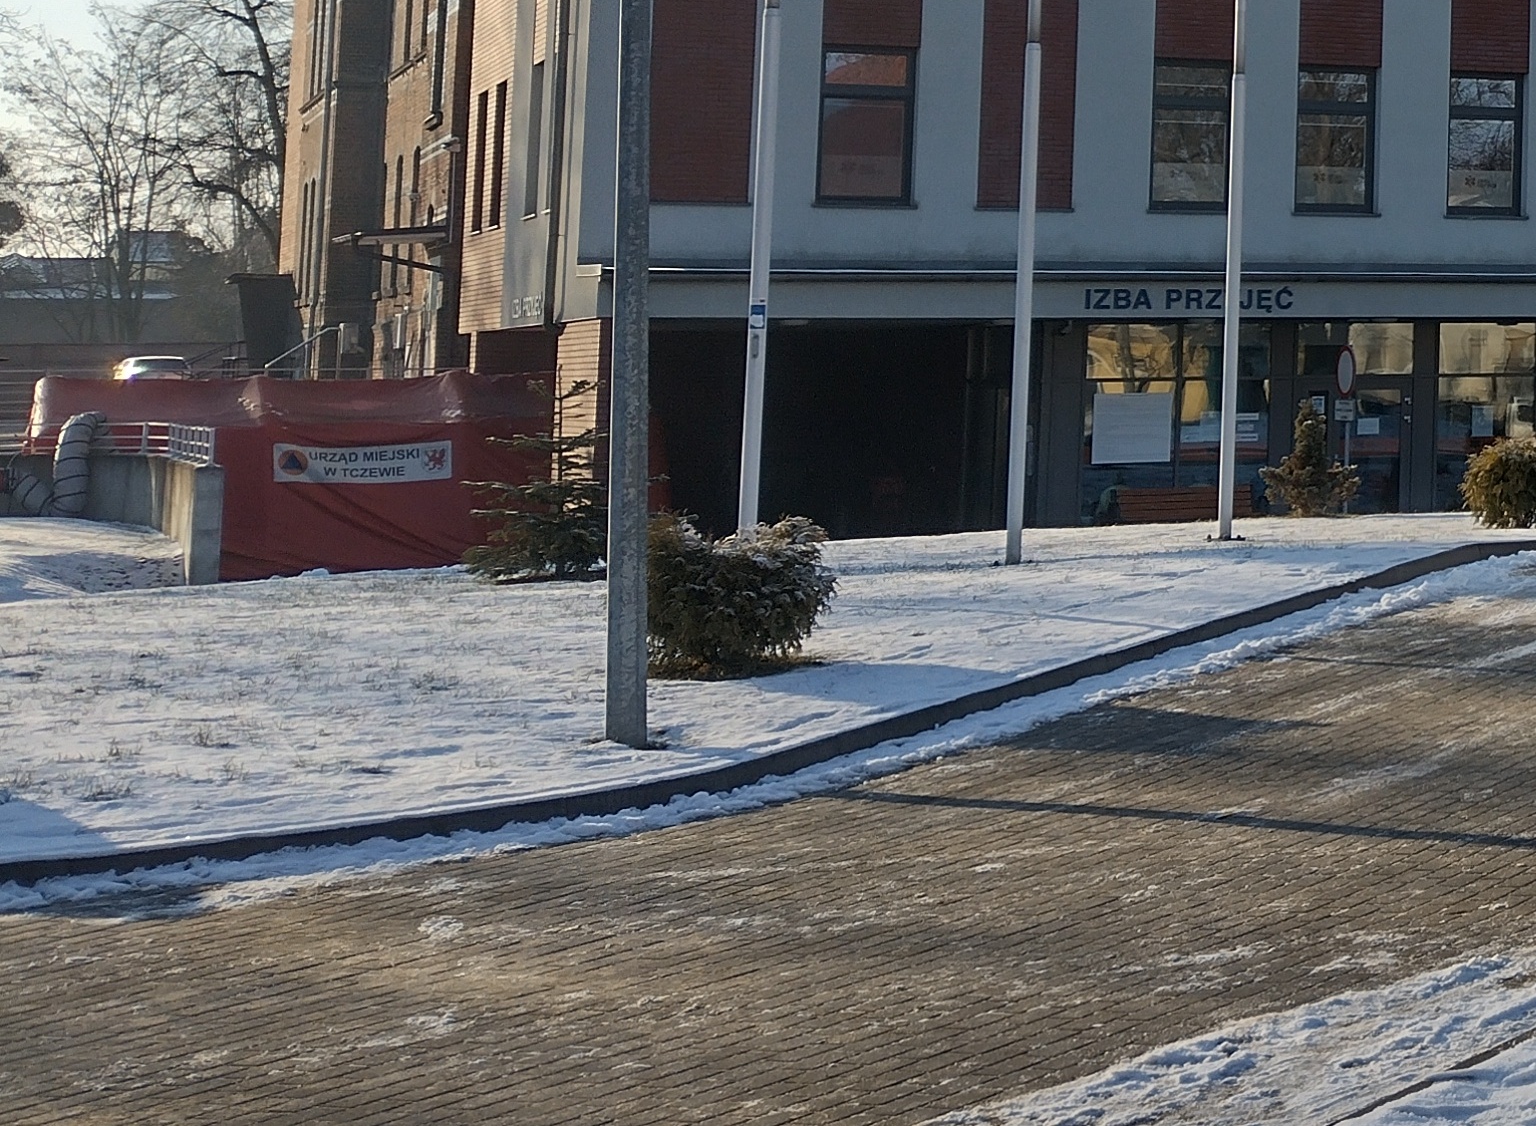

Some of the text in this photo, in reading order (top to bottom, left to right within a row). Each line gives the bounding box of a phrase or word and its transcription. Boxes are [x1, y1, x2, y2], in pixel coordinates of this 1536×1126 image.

[1084, 286, 1294, 313] IZBA PRZJĘĆ
[309, 448, 420, 465] URZĄD MIEJSKI
[324, 466, 405, 478] W TCZEWIE
